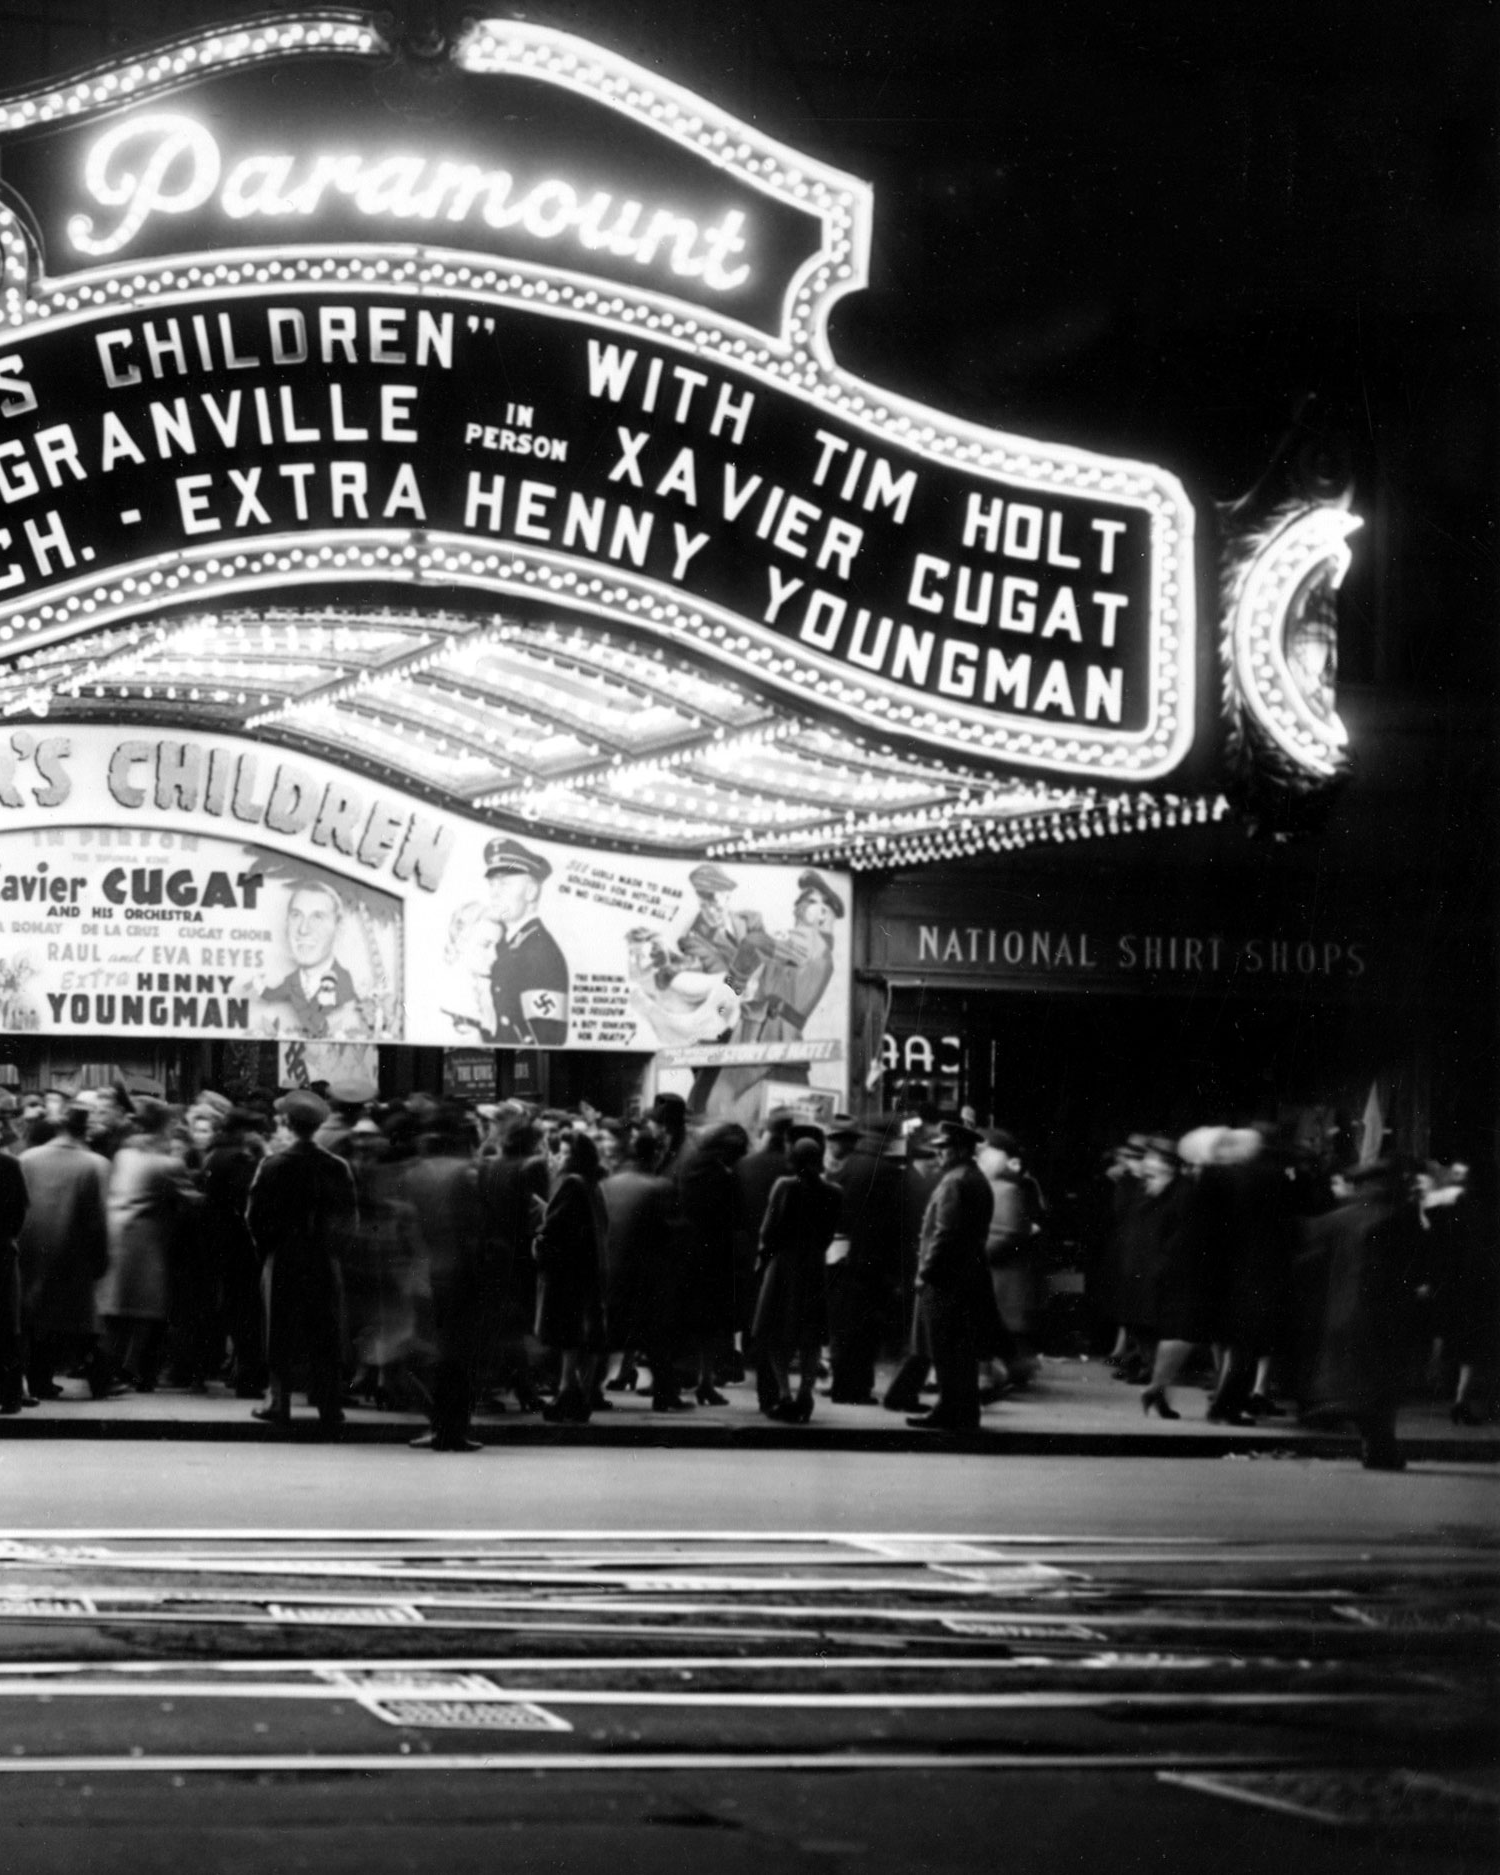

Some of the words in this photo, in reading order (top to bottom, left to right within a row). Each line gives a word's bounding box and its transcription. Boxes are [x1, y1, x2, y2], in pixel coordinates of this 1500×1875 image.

[66, 113, 750, 291] Paramount
[506, 404, 533, 429] IN
[96, 307, 495, 388] CHILDREN"
[587, 339, 754, 442] WITH
[814, 431, 917, 525] TIM
[962, 493, 1126, 573] HOLT
[465, 424, 569, 462] PERSON
[609, 427, 863, 580] XAVIER
[177, 463, 426, 535] EXTRA
[464, 472, 709, 580] HENNY
[764, 567, 1123, 721] YOUNGMAN
[908, 554, 1128, 648] CUGAT
[108, 740, 454, 893] CHILDREN
[103, 867, 265, 910] CUGAT
[47, 905, 80, 918] AND
[91, 907, 113, 919] HIS
[123, 908, 203, 922] ORCHESTRA
[81, 923, 98, 936] DE
[104, 924, 121, 936] LA
[126, 925, 160, 937] CRUZ
[178, 927, 223, 940] CUGAT
[230, 928, 272, 942] CHOIR
[47, 942, 101, 962] RAUL
[108, 947, 145, 964] and
[152, 946, 190, 966] EVA
[201, 948, 265, 968] REYES
[919, 925, 1097, 967] NATIONAL
[1119, 935, 1224, 971] SHIRT
[1244, 939, 1366, 977] SHOPS
[137, 972, 236, 995] HENNY
[46, 992, 250, 1030] YOUNGMAN
